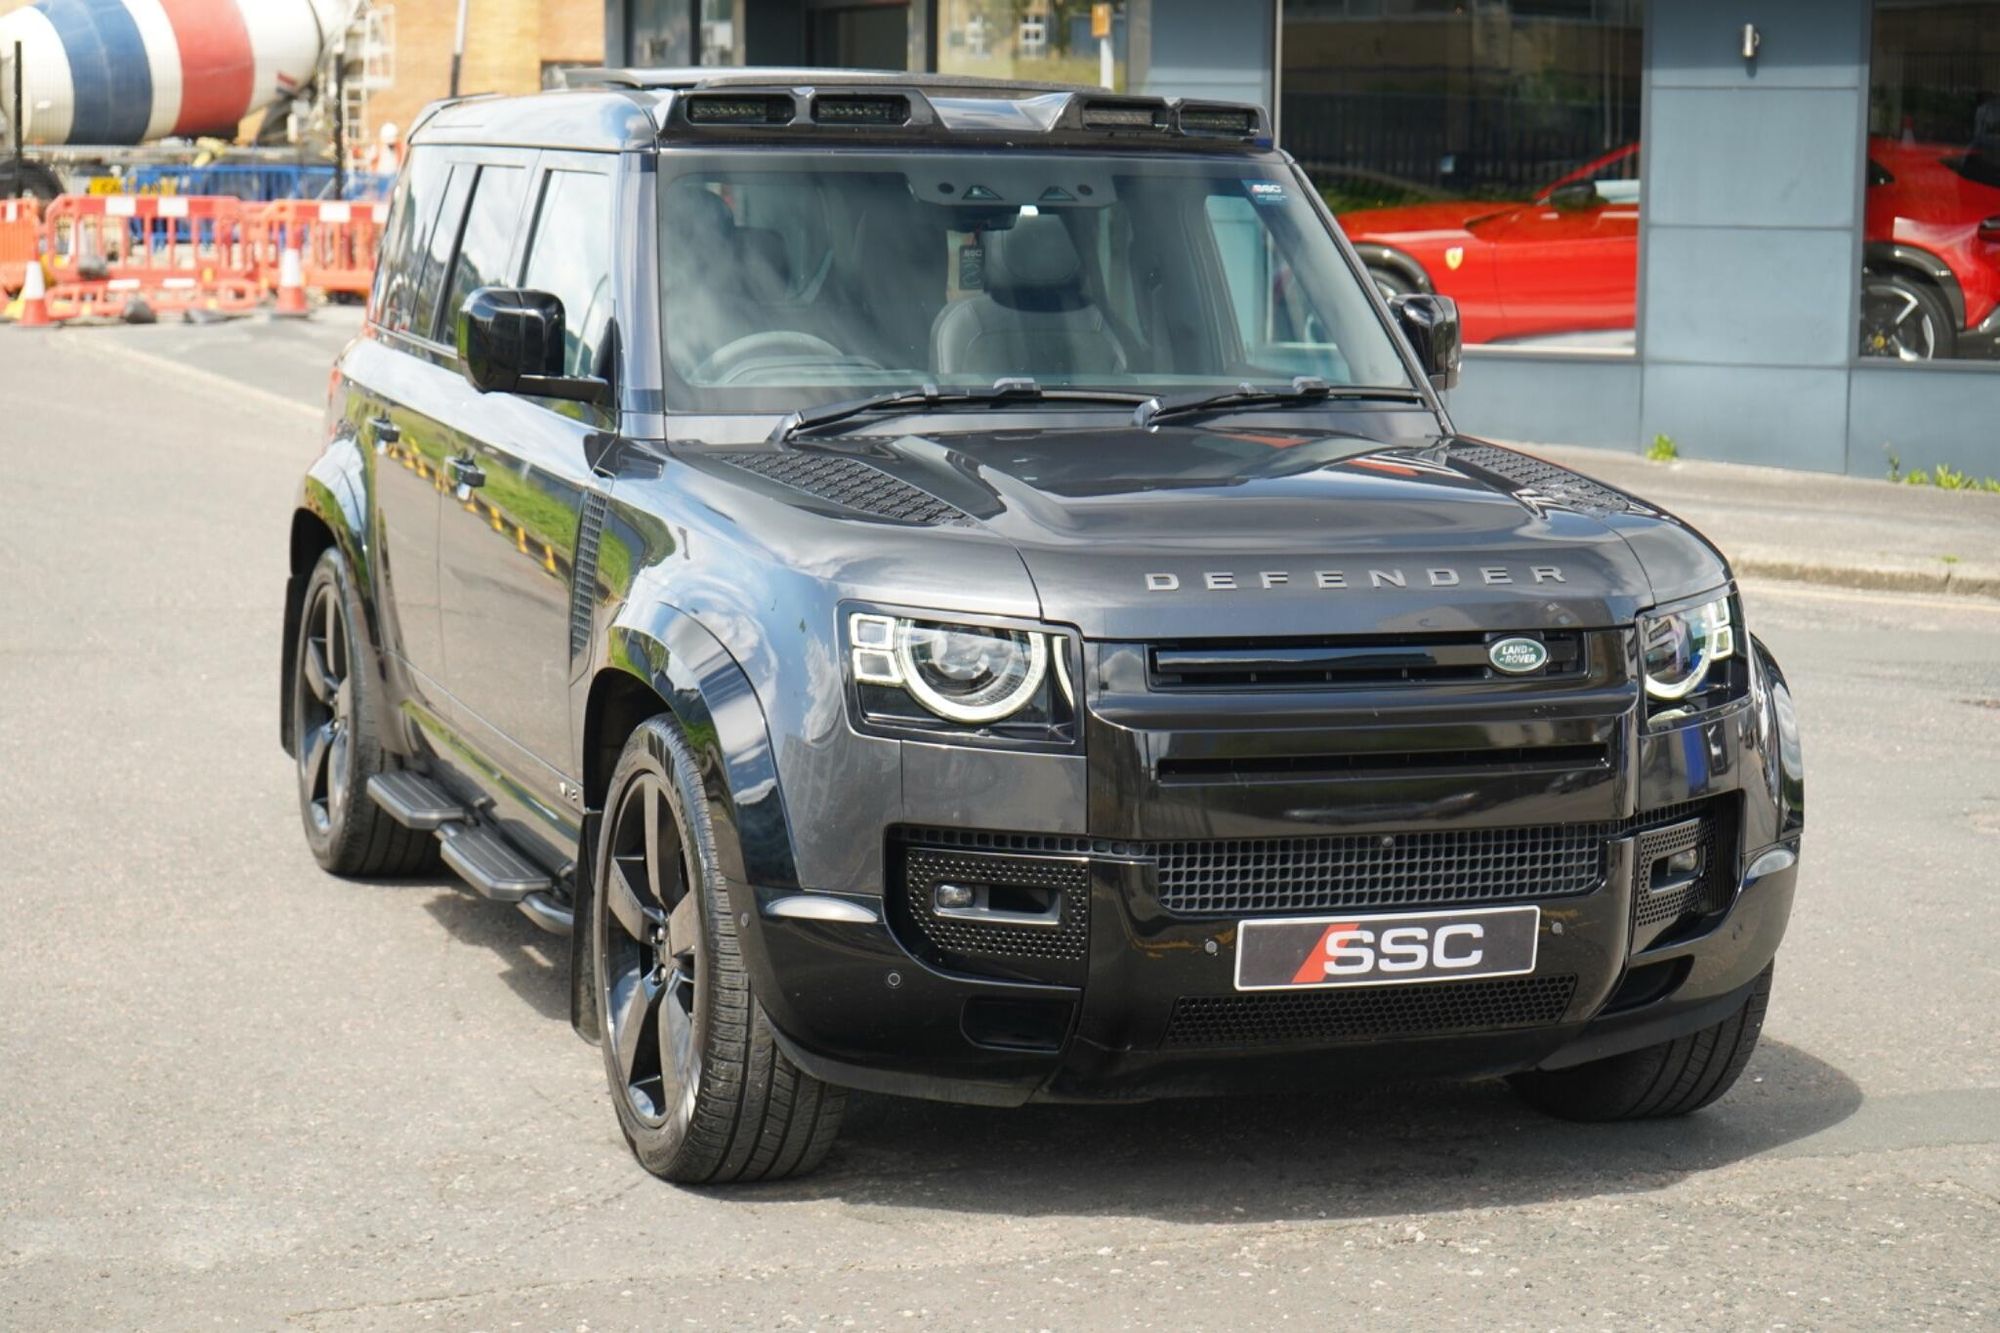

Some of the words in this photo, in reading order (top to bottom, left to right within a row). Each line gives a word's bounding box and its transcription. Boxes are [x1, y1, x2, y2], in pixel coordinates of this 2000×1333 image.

[1144, 566, 1566, 591] DEFENDER
[1502, 645, 1528, 655] LAND
[1505, 654, 1537, 664] ROVER
[1323, 923, 1484, 976] SSC
